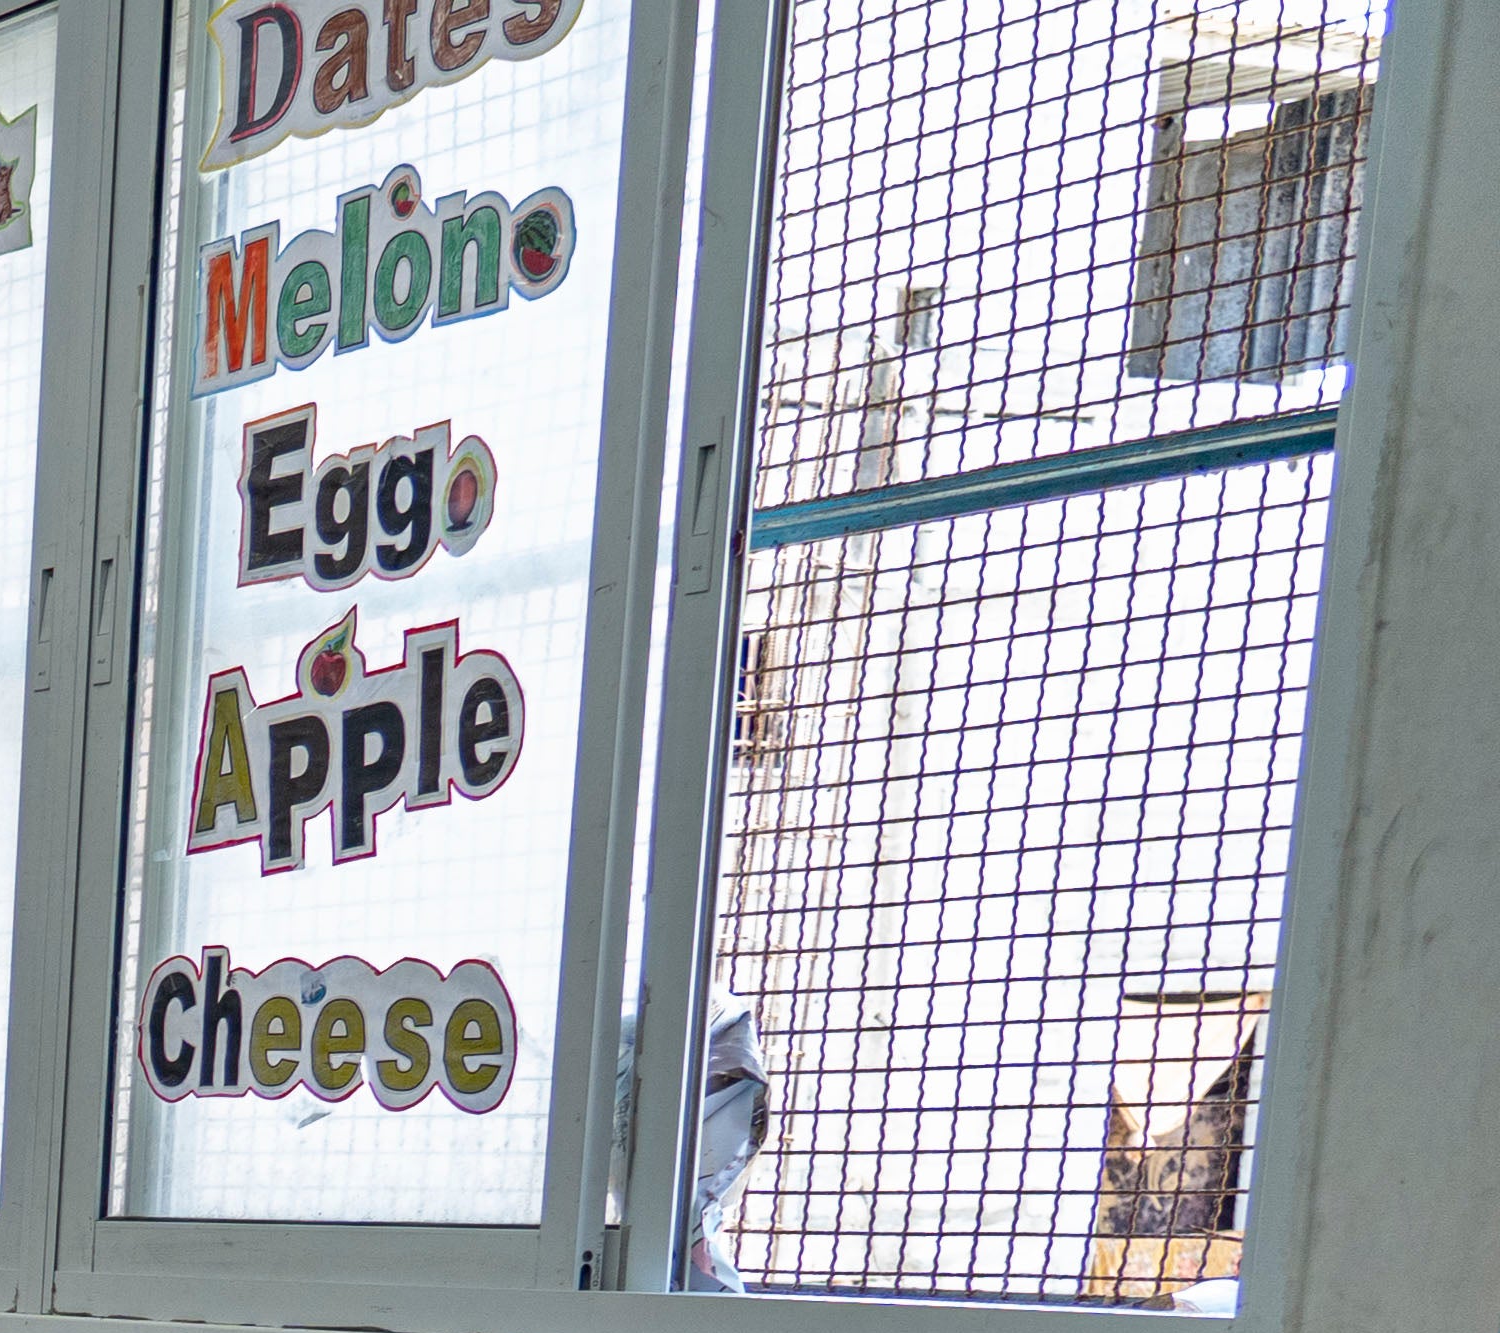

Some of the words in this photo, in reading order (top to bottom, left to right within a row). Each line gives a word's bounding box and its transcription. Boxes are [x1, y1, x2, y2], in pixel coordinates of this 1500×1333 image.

[204, 190, 502, 385] Melon
[246, 421, 435, 579] Egg
[197, 646, 508, 862] Apple
[150, 952, 502, 1093] Cheese
